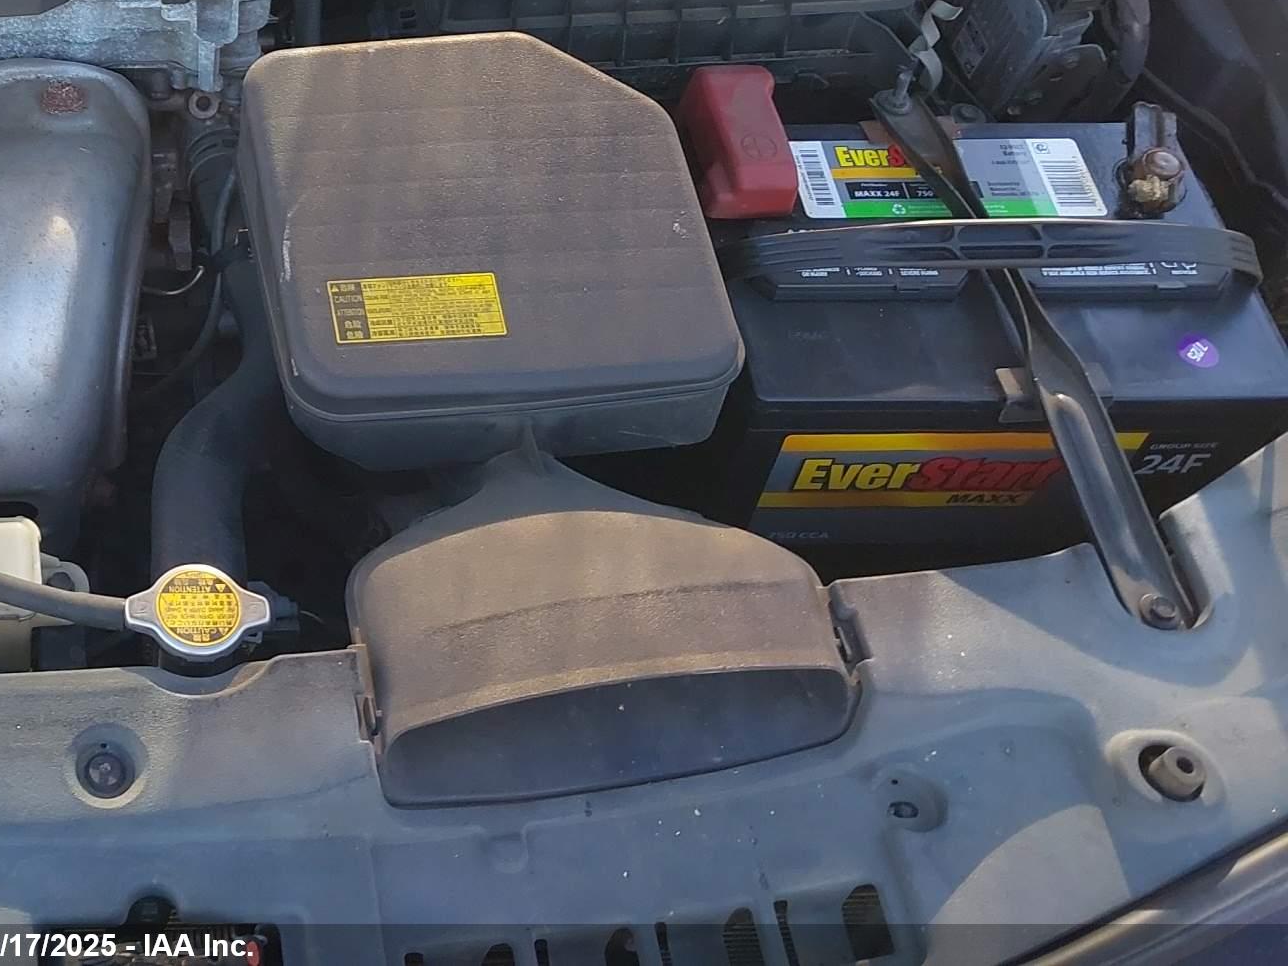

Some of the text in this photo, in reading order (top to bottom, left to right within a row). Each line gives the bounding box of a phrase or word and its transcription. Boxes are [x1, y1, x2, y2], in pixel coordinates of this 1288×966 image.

[834, 144, 908, 168] EverS
[792, 455, 1064, 492] EverStart
[1133, 453, 1211, 474] 24F
[945, 492, 1024, 504] MAXX
[168, 585, 212, 593] ATTENTION
